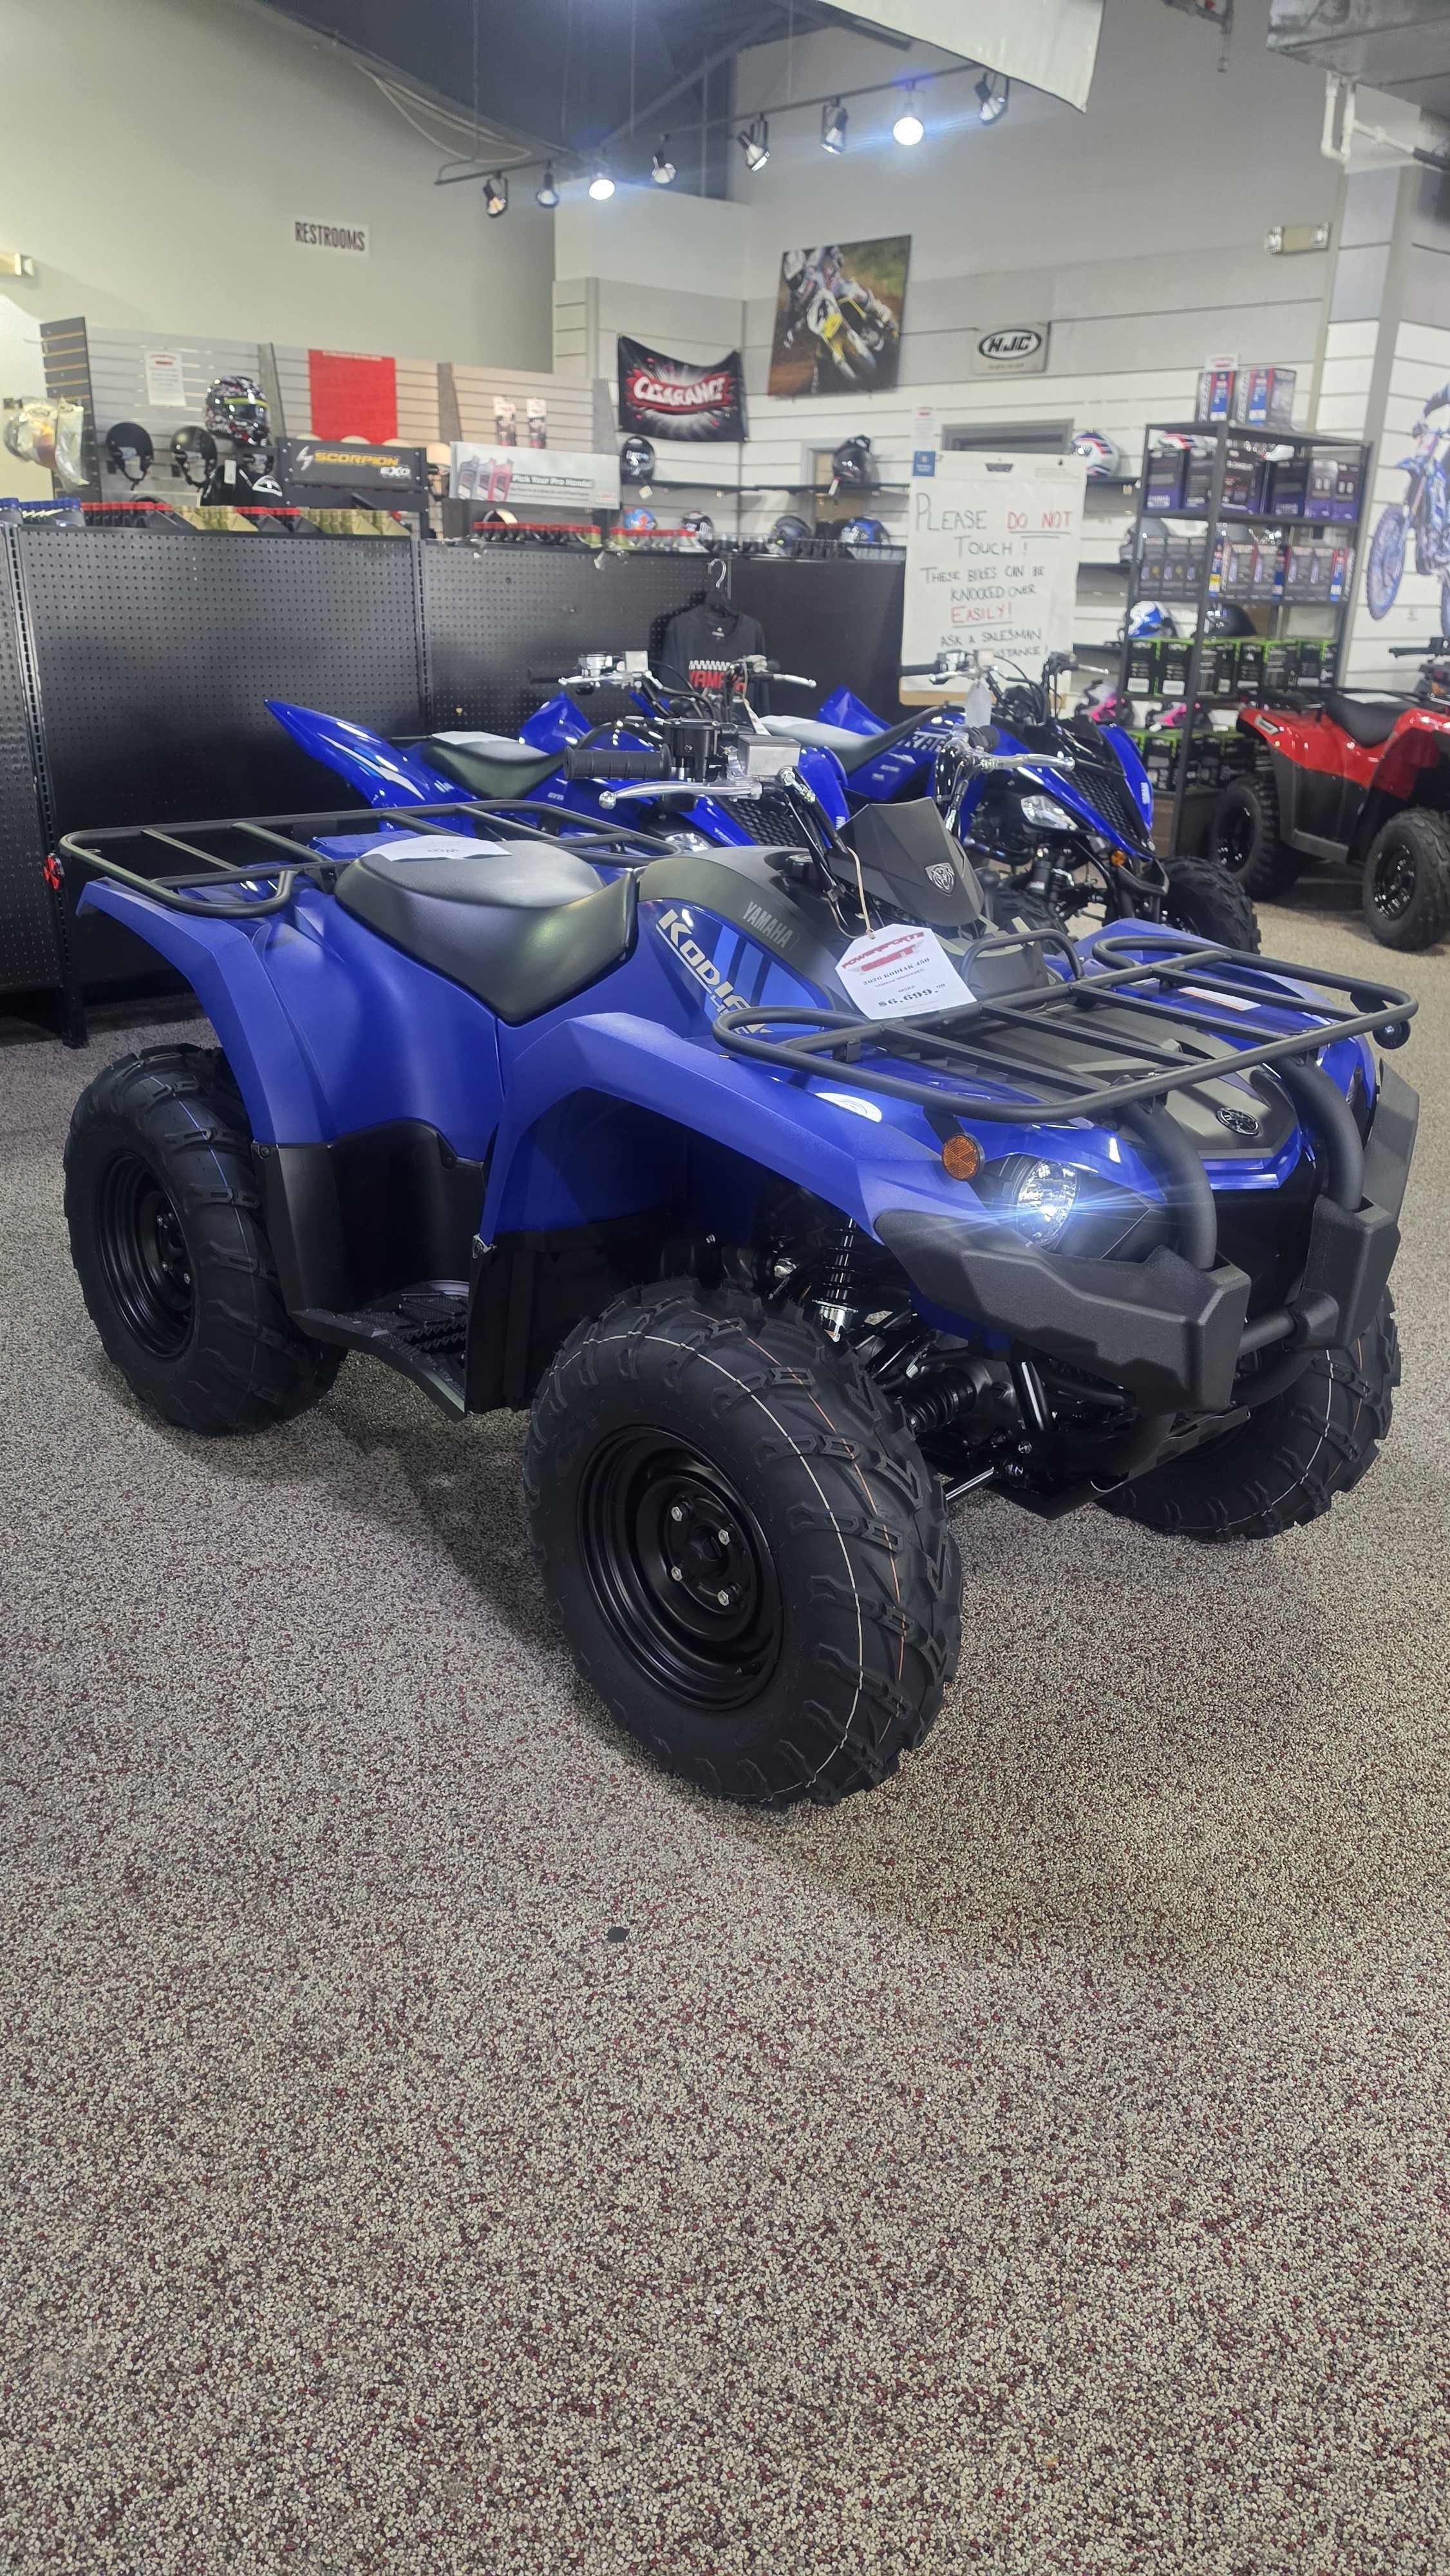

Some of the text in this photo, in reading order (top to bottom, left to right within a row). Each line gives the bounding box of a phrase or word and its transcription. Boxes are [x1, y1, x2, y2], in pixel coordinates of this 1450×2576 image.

[295, 222, 365, 251] RESTROOMS
[988, 336, 1031, 352] HJC
[634, 376, 726, 406] CLEARANCE
[314, 451, 399, 466] SCORPION
[915, 492, 1073, 531] PLEASE DO NOT
[954, 535, 1013, 558] TOUCH
[919, 565, 1046, 583] THESE BIKES CAN BE
[950, 583, 1037, 602] KNOCKED OVER
[941, 629, 1042, 647] ASK A SALESMAN
[742, 902, 793, 948] YAMAHA
[863, 958, 930, 985] 2026 KODIAK 450
[898, 985, 916, 993] MSRP
